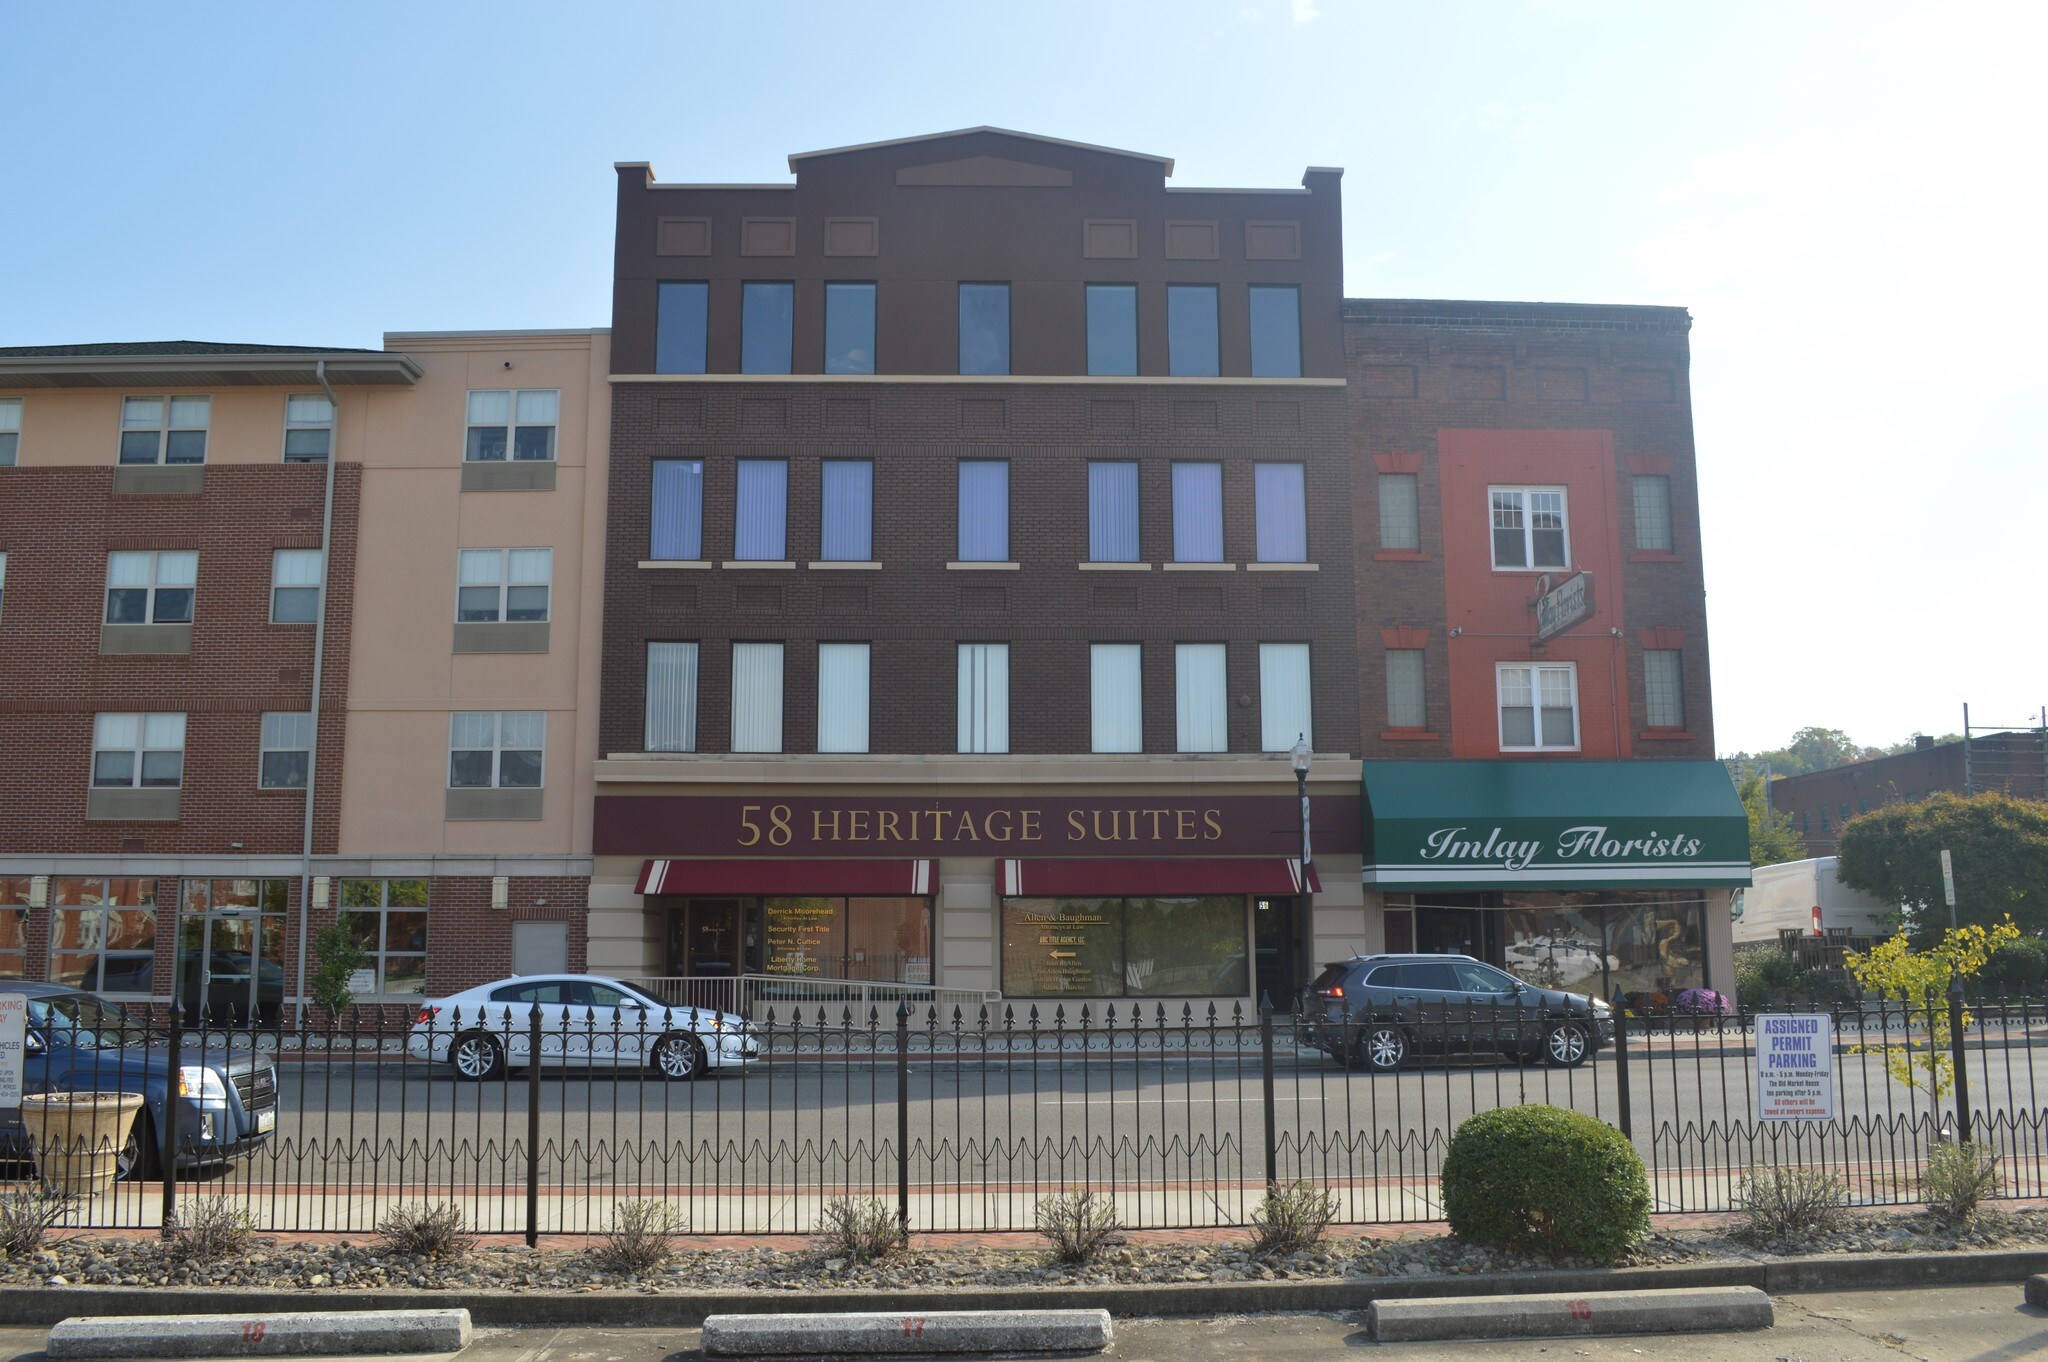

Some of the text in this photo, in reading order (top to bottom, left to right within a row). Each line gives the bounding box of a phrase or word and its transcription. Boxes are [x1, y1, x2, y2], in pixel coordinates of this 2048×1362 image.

[737, 805, 1222, 846] 58 HERITAGE SUITES
[1420, 826, 1705, 871] Imlay Florists
[1024, 913, 1102, 923] Allen & Baughman
[767, 925, 797, 933] Security
[766, 964, 820, 973] Mortgage Corp.
[1765, 1019, 1818, 1034] ASSIGNED
[1772, 1036, 1812, 1051] PERMIT
[1769, 1053, 1817, 1068] PARKING
[1569, 1299, 1593, 1321] 16
[242, 1322, 265, 1343] 18
[904, 1316, 926, 1338] 17
